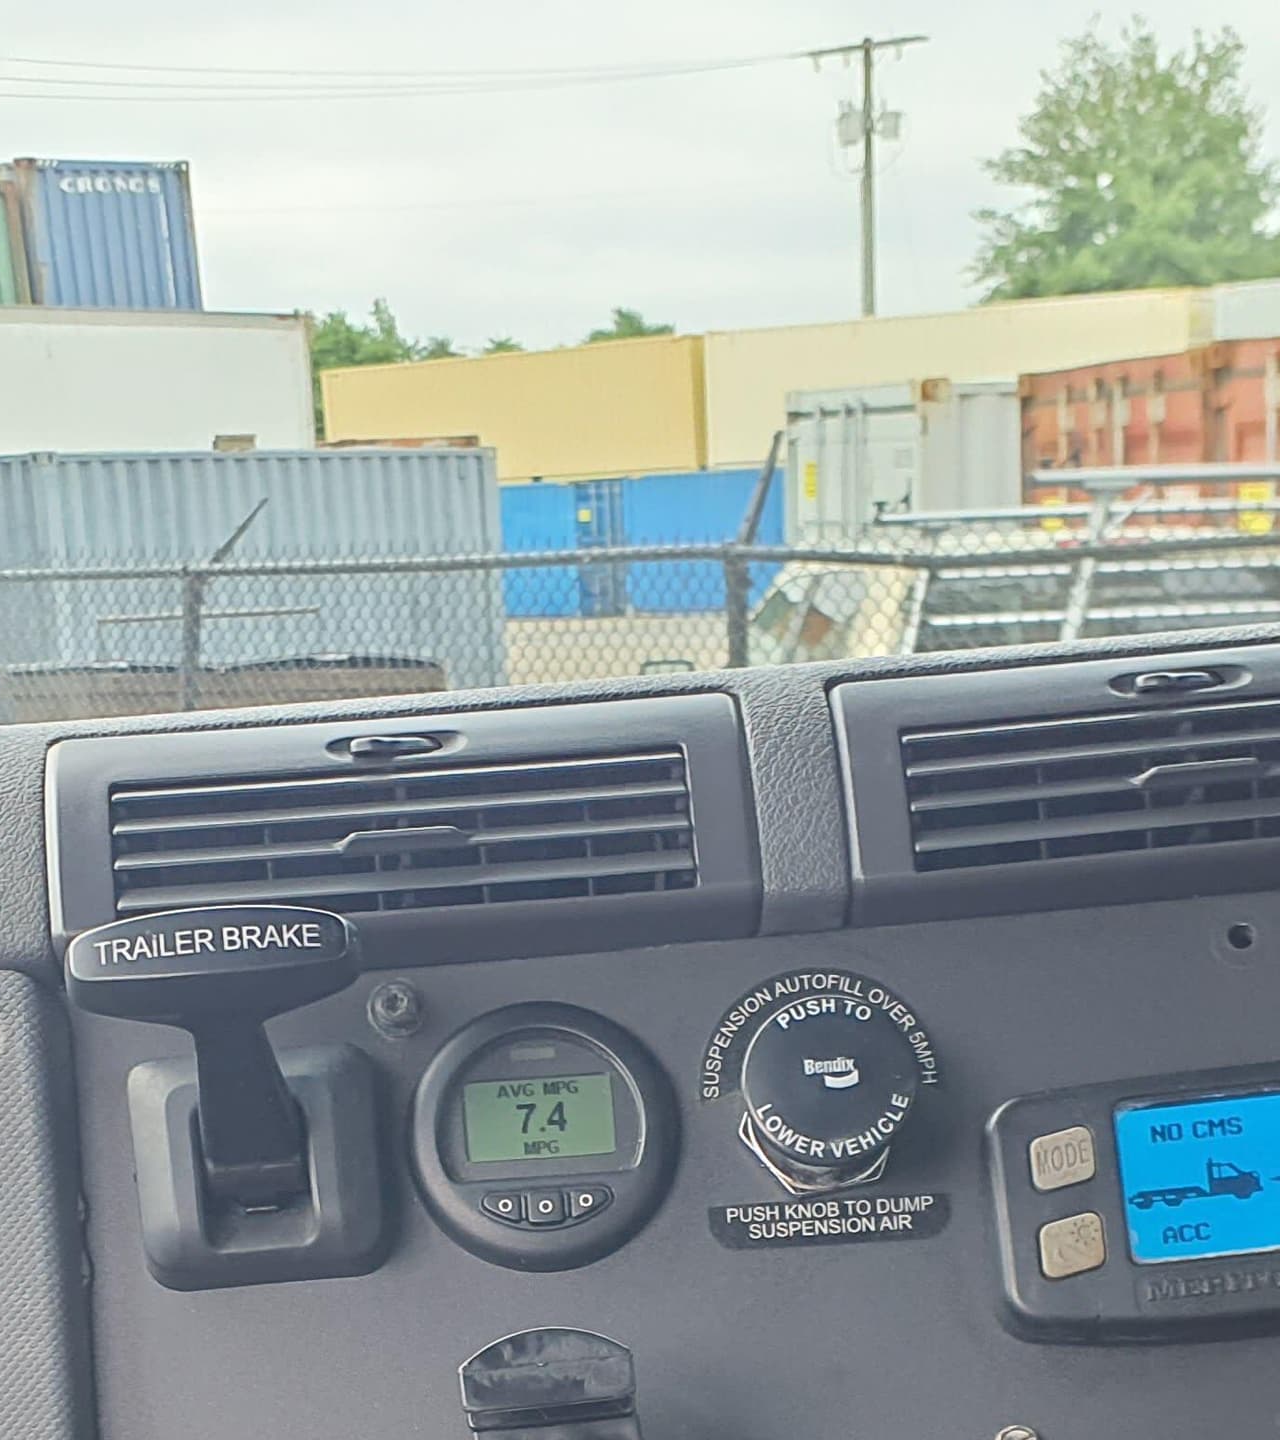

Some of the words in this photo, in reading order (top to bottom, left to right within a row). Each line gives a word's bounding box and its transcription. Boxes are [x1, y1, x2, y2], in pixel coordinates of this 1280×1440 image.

[93, 928, 216, 966] TRAILER
[222, 924, 321, 951] BRAKE
[776, 998, 836, 1030] PUSH
[843, 1000, 872, 1021] TO
[704, 988, 773, 1098] SUSPENSION
[775, 973, 864, 998] AUTOFILL
[868, 988, 916, 1032] OVER
[908, 1031, 938, 1084] 5MPH
[803, 1056, 855, 1076] Bendix
[497, 1083, 535, 1098] AVG
[543, 1080, 579, 1096] MPG
[516, 1101, 567, 1133] 7.4
[756, 1103, 825, 1158] LOWER
[830, 1093, 909, 1158] VEHICLE
[1150, 1123, 1183, 1144] NO
[1192, 1116, 1243, 1139] CMS
[524, 1140, 560, 1155] MPG
[1036, 1138, 1090, 1177] MODE
[726, 1205, 780, 1224] PUSH
[785, 1202, 840, 1220] KNOB
[844, 1199, 870, 1216] TO
[876, 1196, 934, 1214] DUMP
[749, 1217, 875, 1240] SUSPENSION
[880, 1214, 913, 1232] AIR
[1161, 1222, 1212, 1245] ACC
